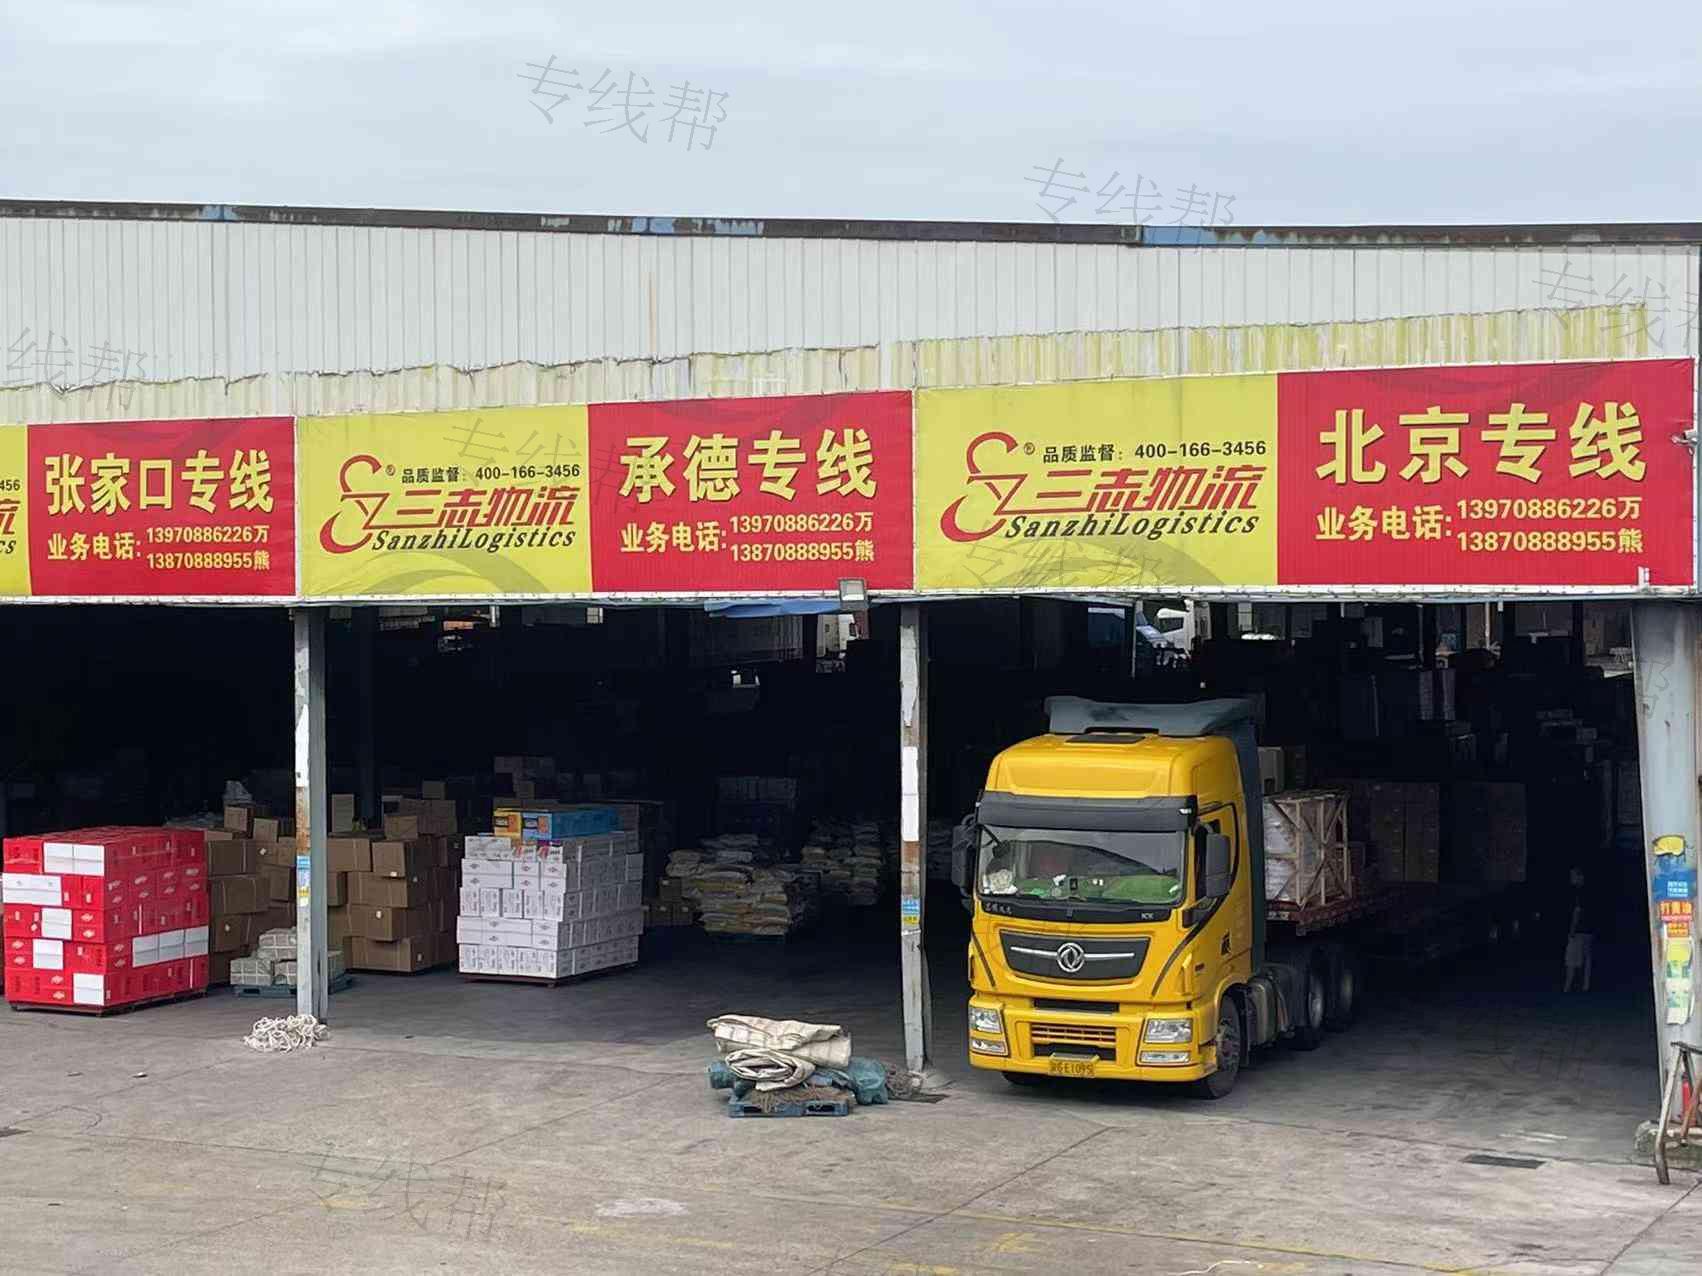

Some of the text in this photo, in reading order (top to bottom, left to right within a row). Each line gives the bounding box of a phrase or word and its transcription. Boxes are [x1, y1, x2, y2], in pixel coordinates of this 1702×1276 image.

[1134, 440, 1267, 459] 400-166-3456
[1315, 402, 1648, 484] 北京专线
[475, 464, 581, 480] 400-166-3456
[619, 429, 877, 502] 承德专线
[45, 449, 275, 516] 张家口专线
[994, 464, 1267, 516] 三志物流
[362, 485, 582, 530] 三志物流
[1456, 496, 1643, 520] 13970886226万
[146, 524, 270, 545] 13970886226万
[729, 512, 874, 533] 13970886226万
[1005, 512, 1260, 541] SanzhiLogistics
[1315, 505, 1452, 541] 业务电话:
[47, 532, 142, 561] 业务电话:
[372, 526, 577, 554] SanzhiLogistics
[621, 521, 728, 553] 业务电话:
[731, 540, 875, 561] 13870888955熊
[1457, 528, 1644, 554] 13870888955熊
[147, 550, 271, 571] 13870888955熊
